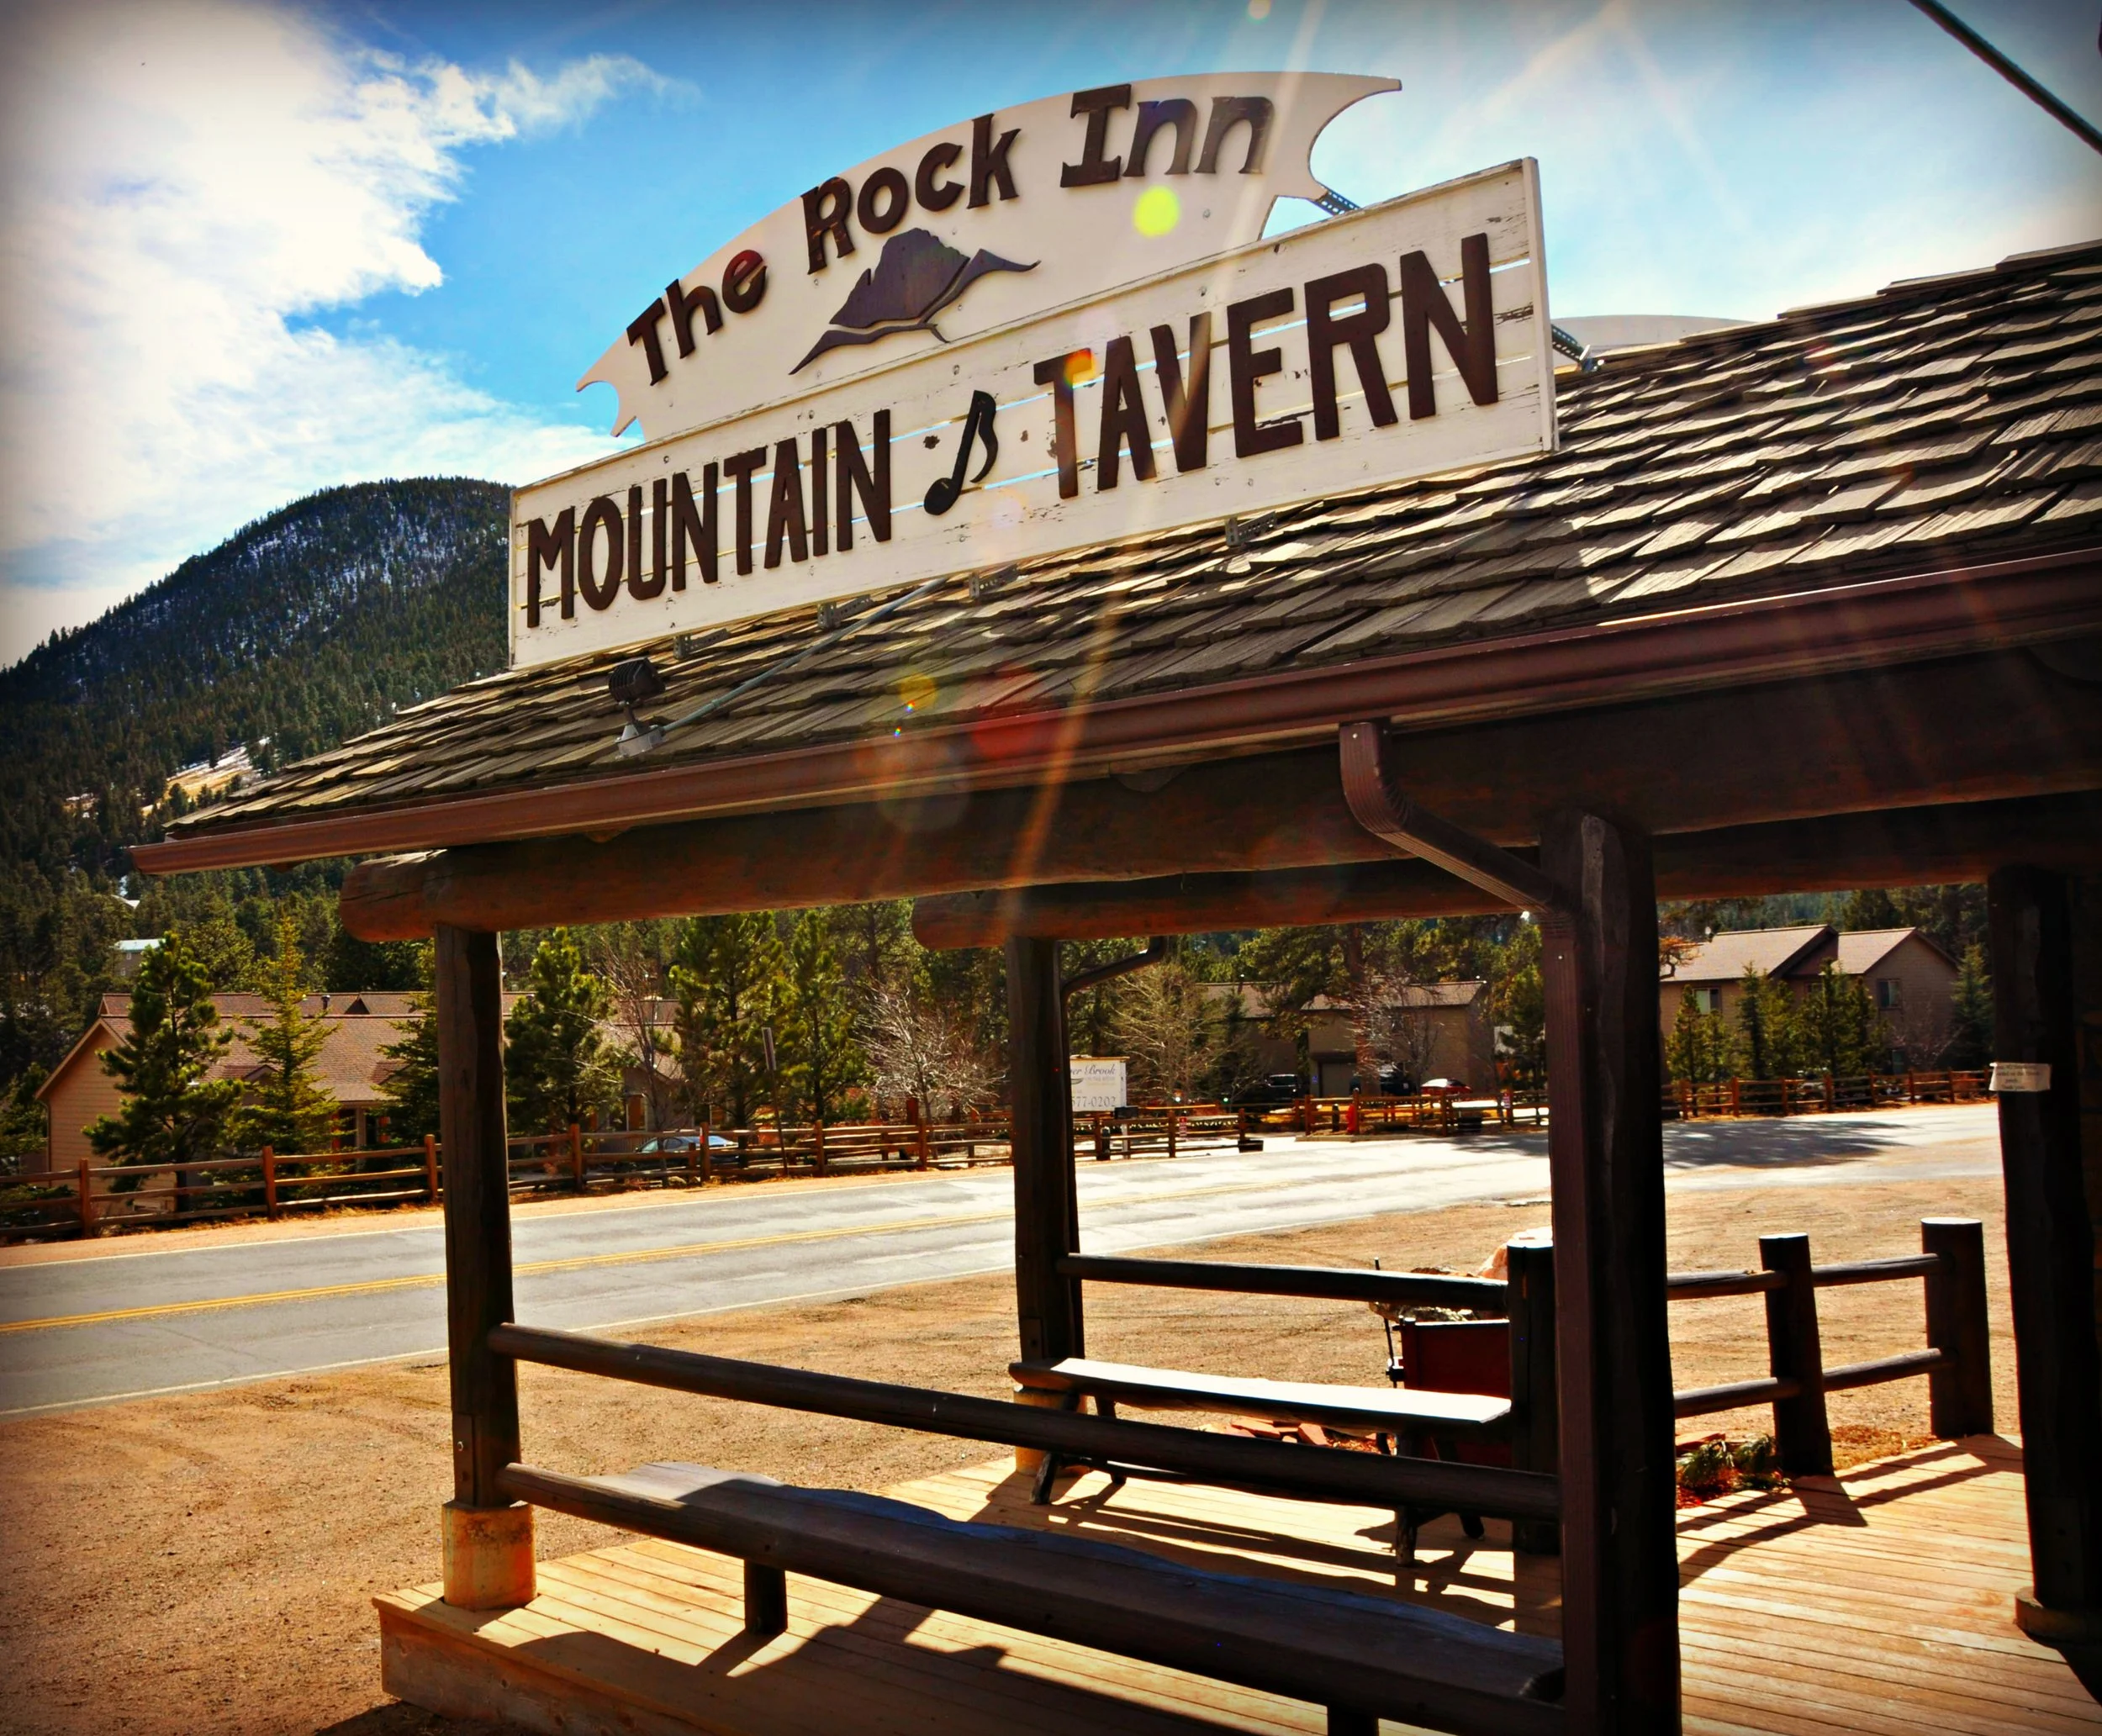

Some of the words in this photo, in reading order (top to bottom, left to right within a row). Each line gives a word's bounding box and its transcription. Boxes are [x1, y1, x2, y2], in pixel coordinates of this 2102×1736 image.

[626, 249, 768, 386] The
[800, 113, 1021, 275] Rock
[1060, 83, 1275, 187] Inn
[526, 409, 891, 629] MOUNTAIN
[1033, 233, 1498, 499] TAVERN
